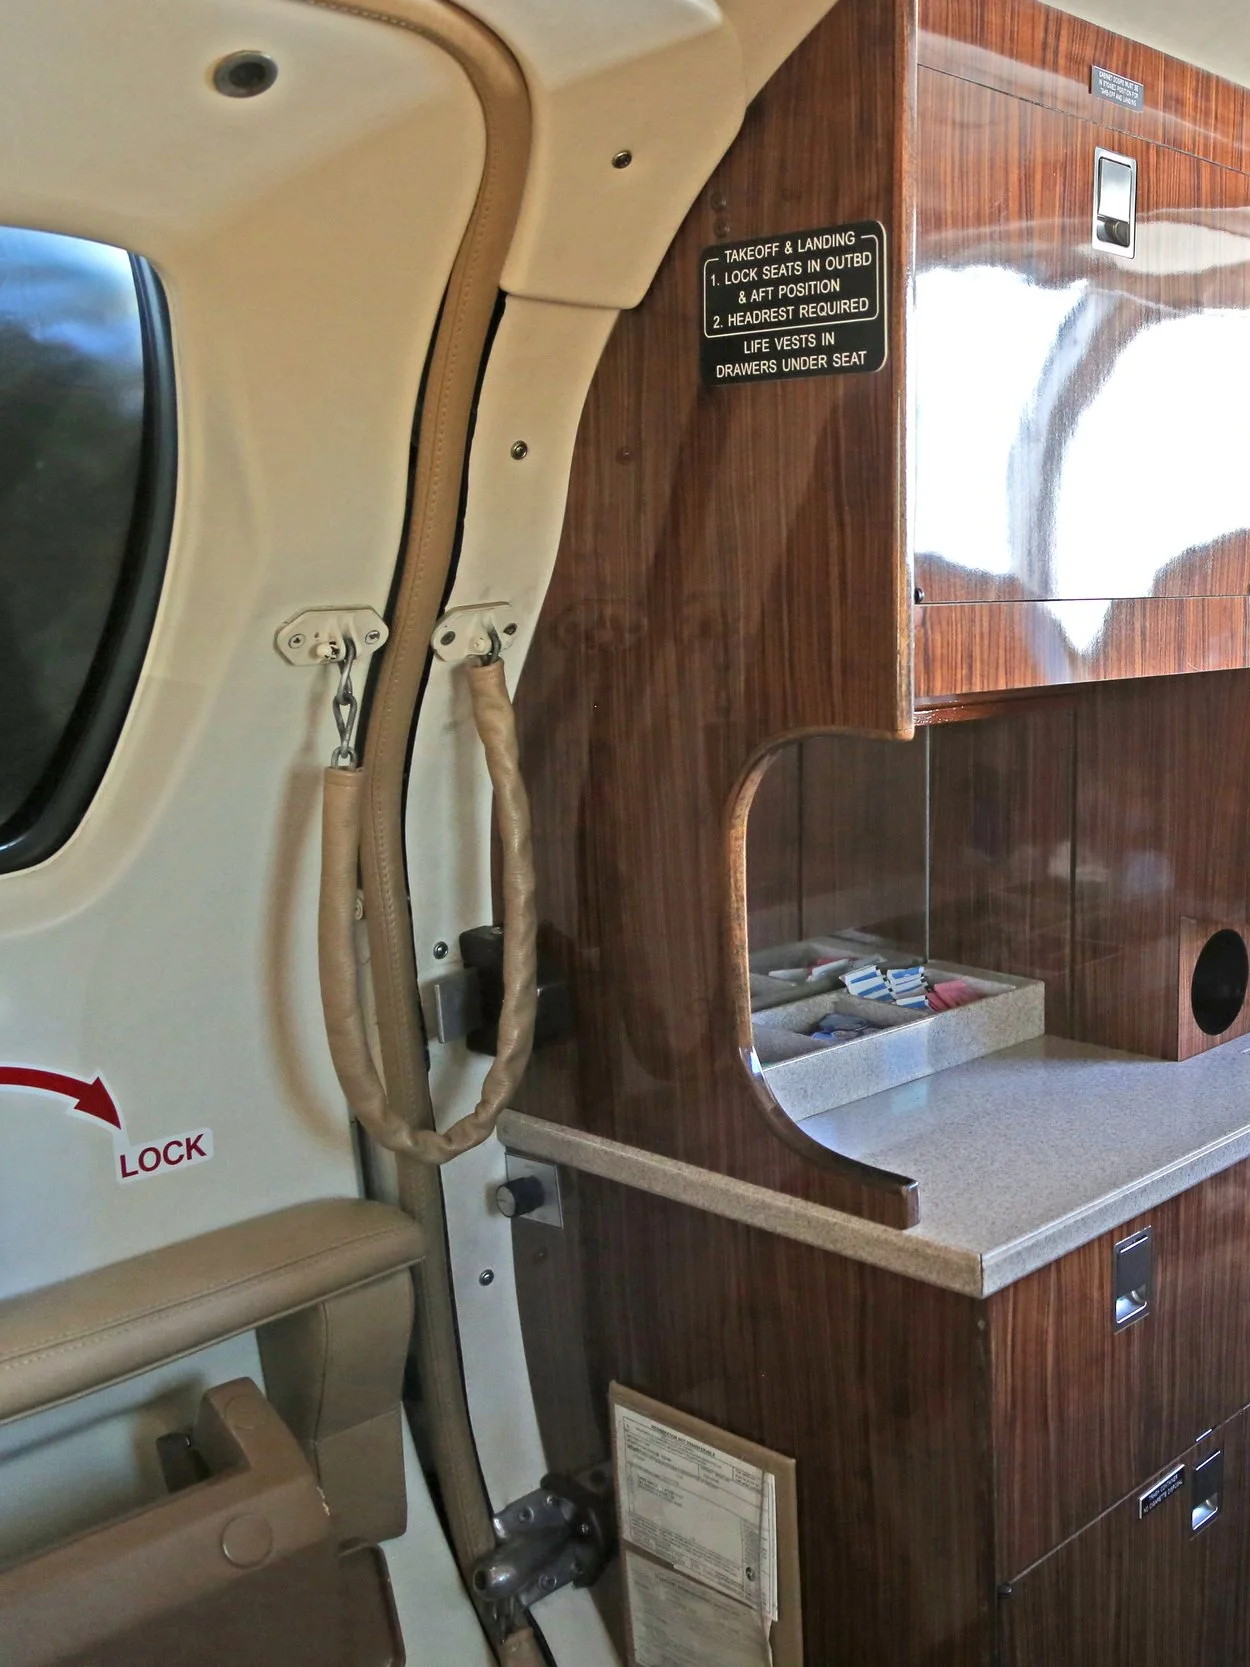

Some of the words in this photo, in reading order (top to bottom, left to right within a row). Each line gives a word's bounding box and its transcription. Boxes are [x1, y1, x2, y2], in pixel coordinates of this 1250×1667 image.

[724, 242, 779, 264] TAKEOFF
[784, 240, 793, 255] &
[797, 231, 856, 253] LANDING
[710, 274, 720, 287] 1.
[725, 267, 758, 285] LOCK
[762, 261, 802, 280] SEATS
[807, 259, 820, 274] IN
[825, 251, 872, 269] OUTBD
[738, 290, 747, 304] &
[750, 287, 774, 303] AFT
[778, 278, 840, 300] POSITION
[713, 315, 723, 329] 2.
[728, 306, 795, 327] HEADREST
[799, 297, 869, 319] REQUIRED
[744, 339, 770, 354] LIFE
[774, 333, 816, 351] VESTS
[821, 332, 835, 347] IN
[716, 359, 777, 378] DRAWERS
[782, 354, 827, 372] UNDER
[832, 351, 867, 367] SEAT
[119, 1133, 207, 1178] LOCK
